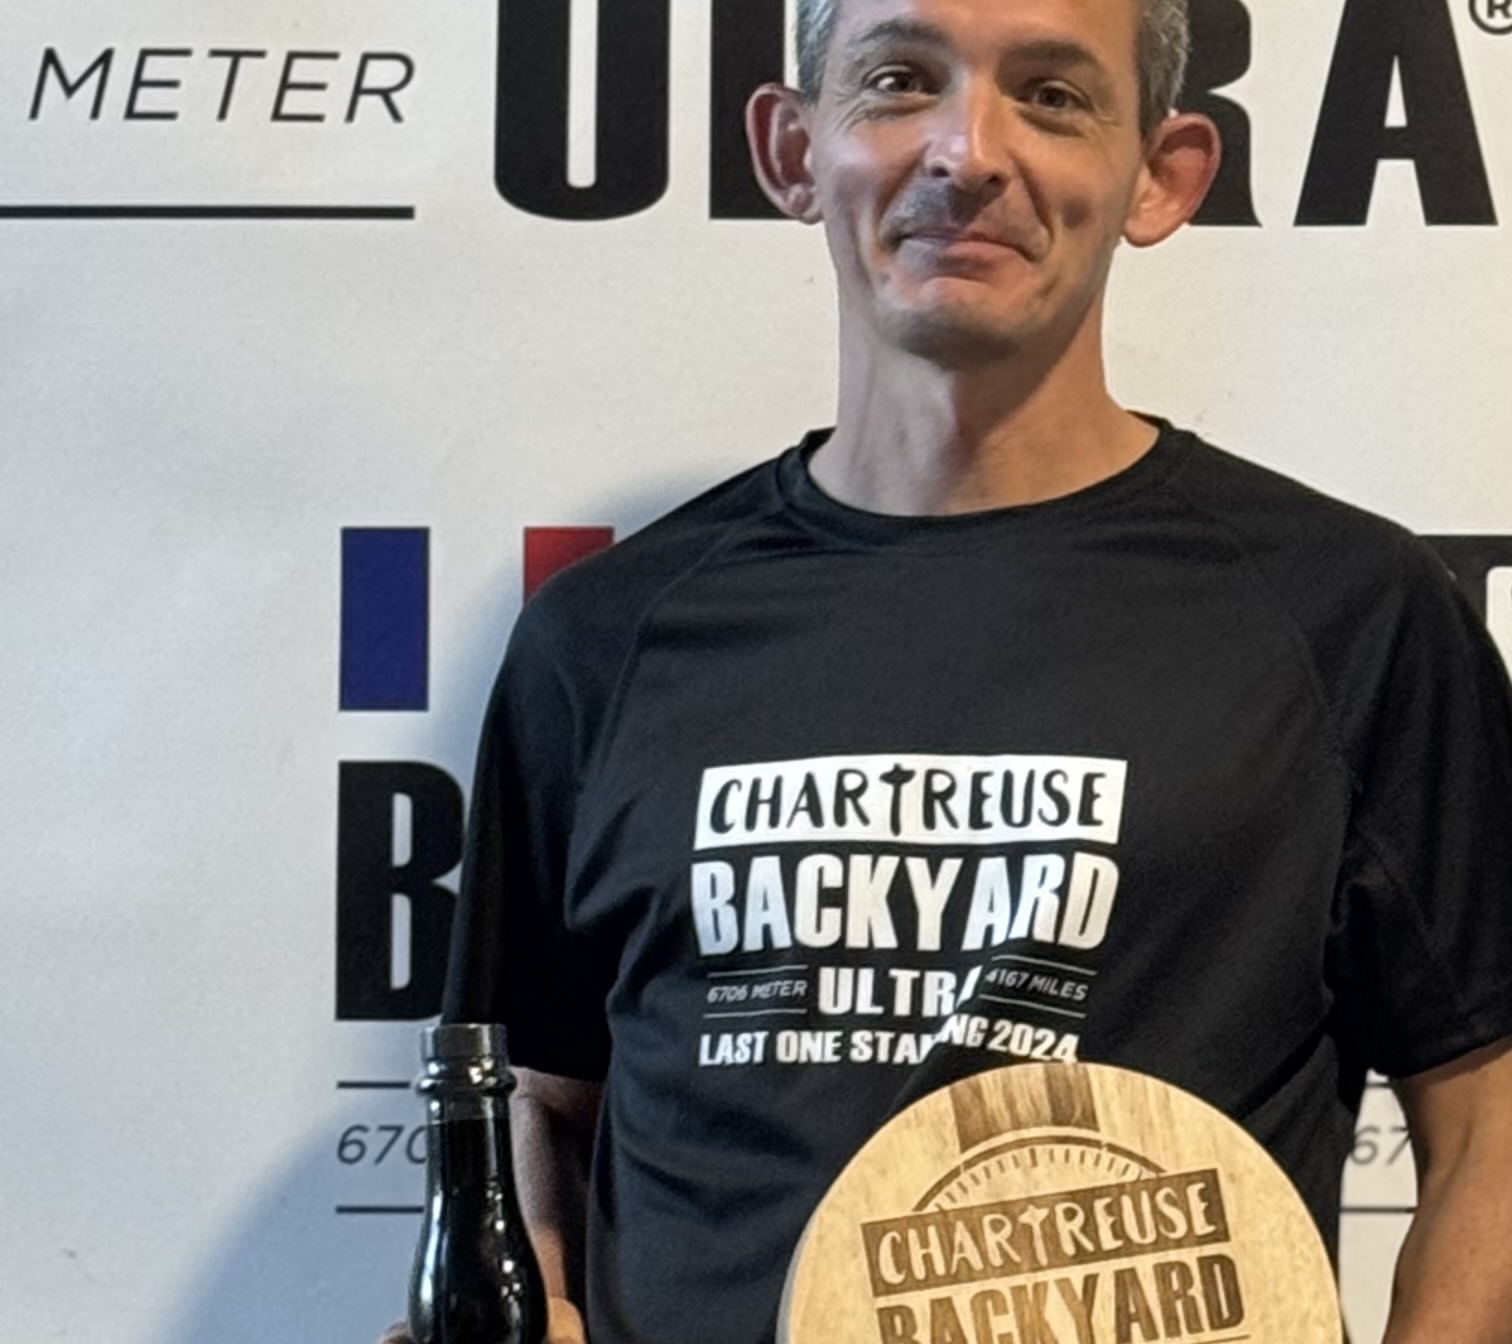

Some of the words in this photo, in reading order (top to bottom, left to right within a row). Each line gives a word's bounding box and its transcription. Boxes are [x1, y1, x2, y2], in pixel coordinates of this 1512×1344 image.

[28, 46, 416, 124] METER
[709, 762, 1107, 837] CHARTREUSE
[690, 851, 1119, 956] BACKYARD
[706, 982, 748, 1003] 6706
[750, 979, 809, 1000] METER
[1028, 974, 1090, 1001] MILES
[699, 1031, 770, 1066] LAST
[775, 1029, 844, 1064] ONE
[987, 1018, 1081, 1064] 2024
[875, 1181, 1219, 1286] CHARTREUSE
